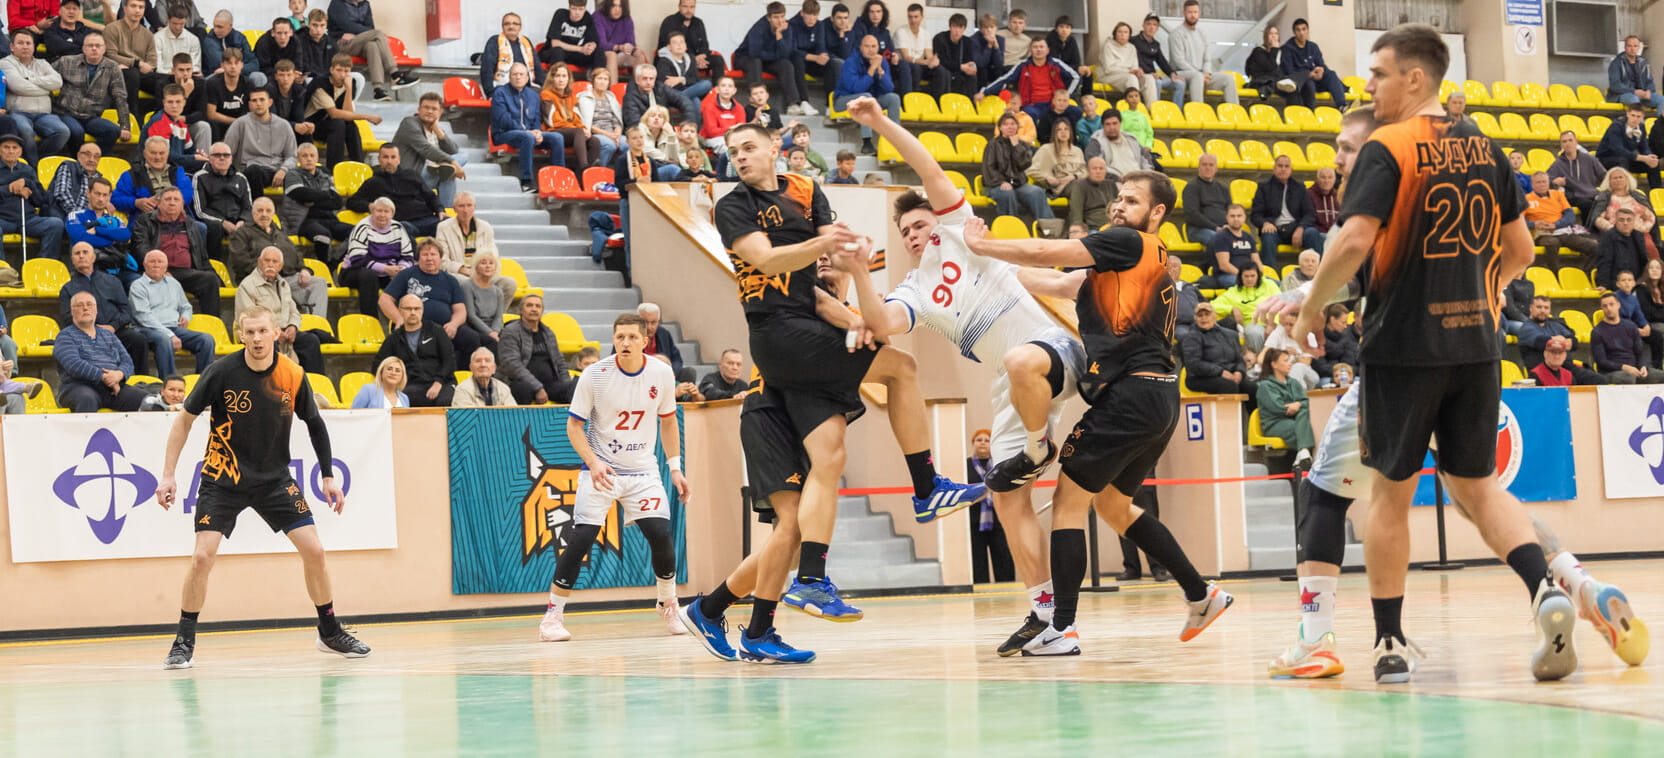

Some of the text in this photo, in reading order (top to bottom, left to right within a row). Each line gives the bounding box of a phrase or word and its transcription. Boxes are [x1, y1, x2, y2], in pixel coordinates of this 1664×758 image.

[1415, 136, 1496, 176] ДУДИК
[1424, 179, 1496, 258] 20
[1232, 240, 1251, 249] FILA
[932, 261, 961, 307] 90
[223, 389, 252, 413] 26
[615, 410, 645, 430] 27
[638, 497, 661, 511] 27
